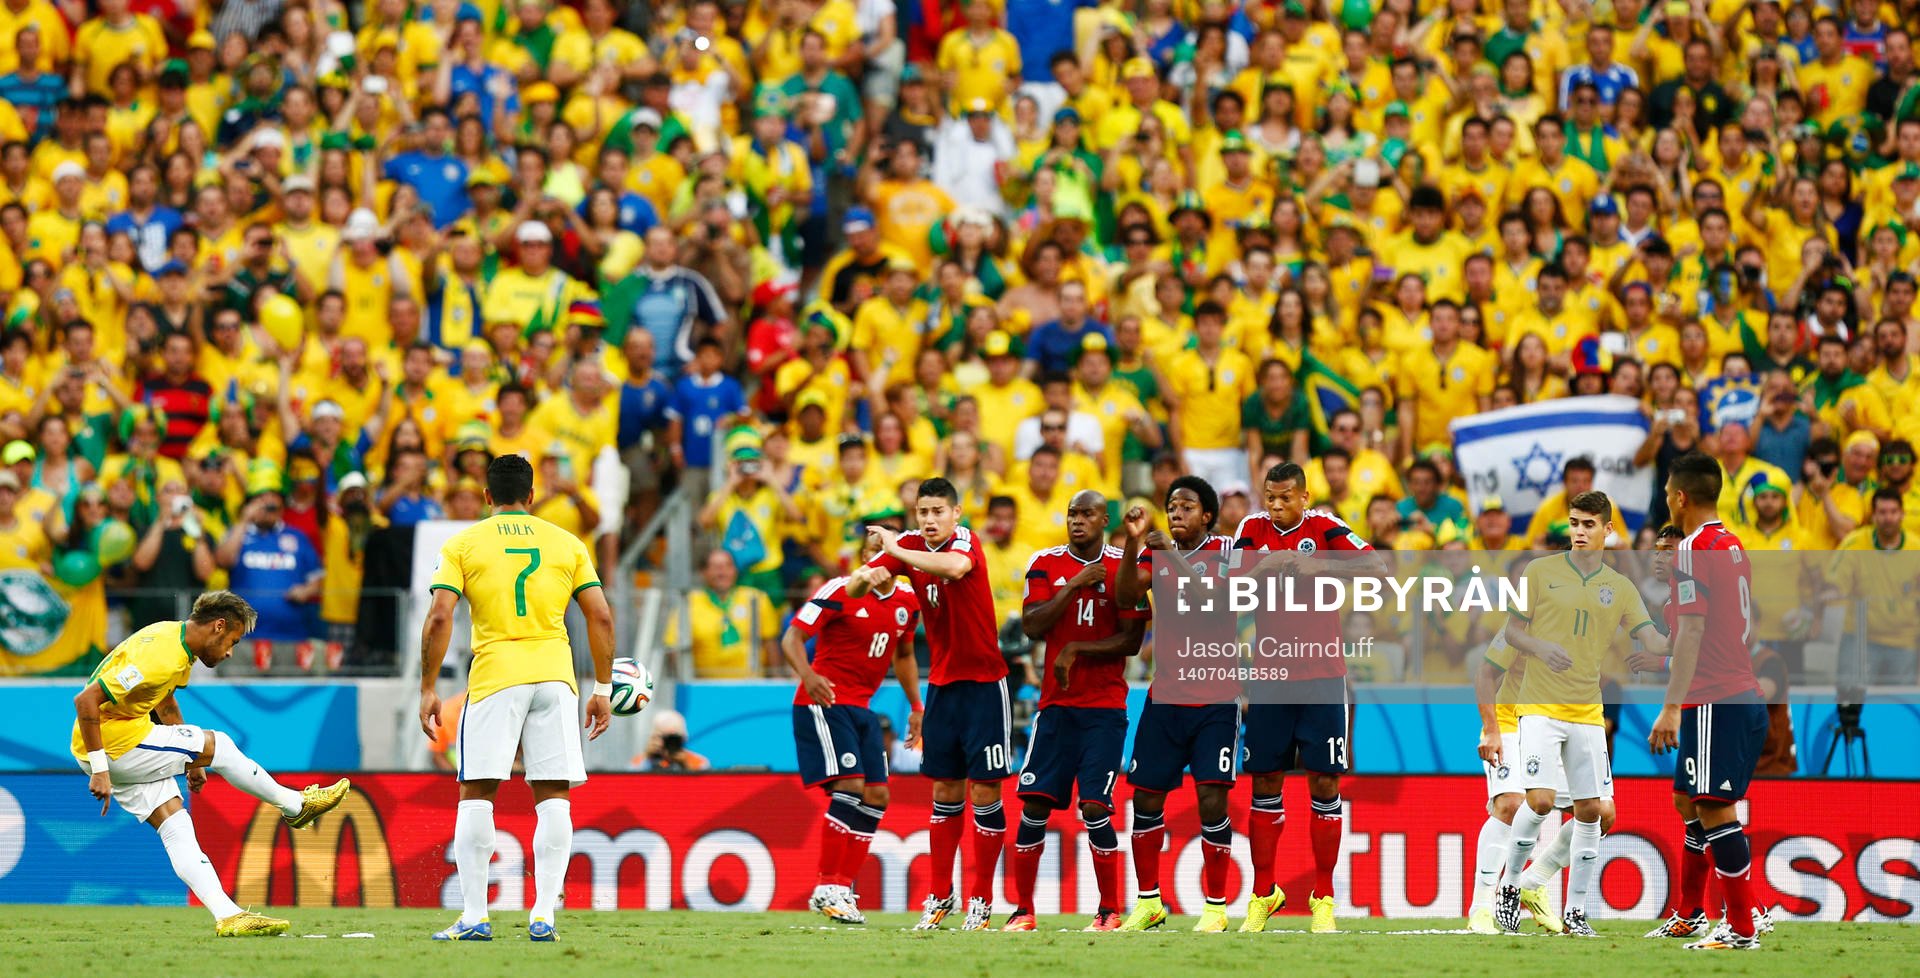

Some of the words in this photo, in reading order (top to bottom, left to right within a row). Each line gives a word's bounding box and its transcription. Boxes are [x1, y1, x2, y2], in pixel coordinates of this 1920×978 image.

[496, 523, 535, 536] HULK
[504, 547, 542, 617] 7
[1076, 598, 1095, 627] 14
[1573, 608, 1589, 637] 11
[1738, 575, 1752, 646] 9
[868, 631, 890, 658] 18
[983, 743, 1005, 771] 10
[1218, 746, 1231, 773] 6
[1327, 737, 1346, 765] 13
[1685, 756, 1697, 786] 9
[441, 828, 776, 912] amo
[1735, 799, 1920, 922] ss
